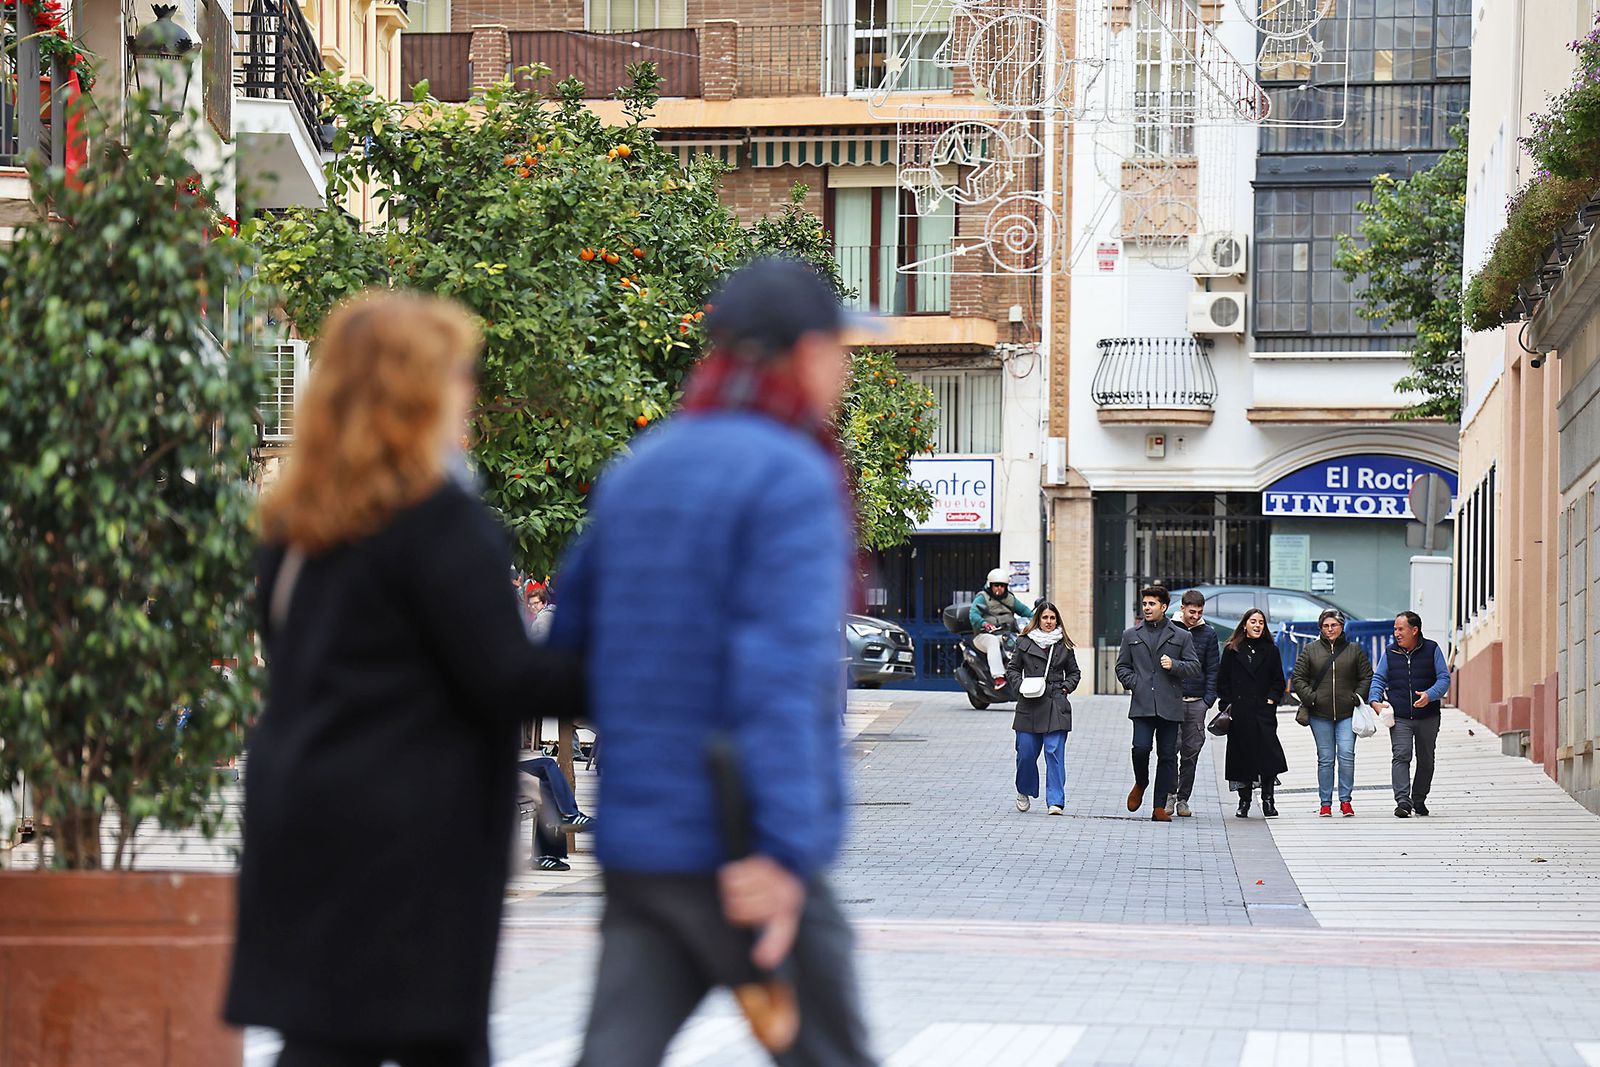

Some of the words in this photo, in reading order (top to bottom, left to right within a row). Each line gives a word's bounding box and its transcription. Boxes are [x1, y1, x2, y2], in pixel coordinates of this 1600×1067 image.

[1326, 466, 1349, 489] El
[1357, 467, 1424, 490] Roci
[1270, 494, 1458, 515] TINTOR
